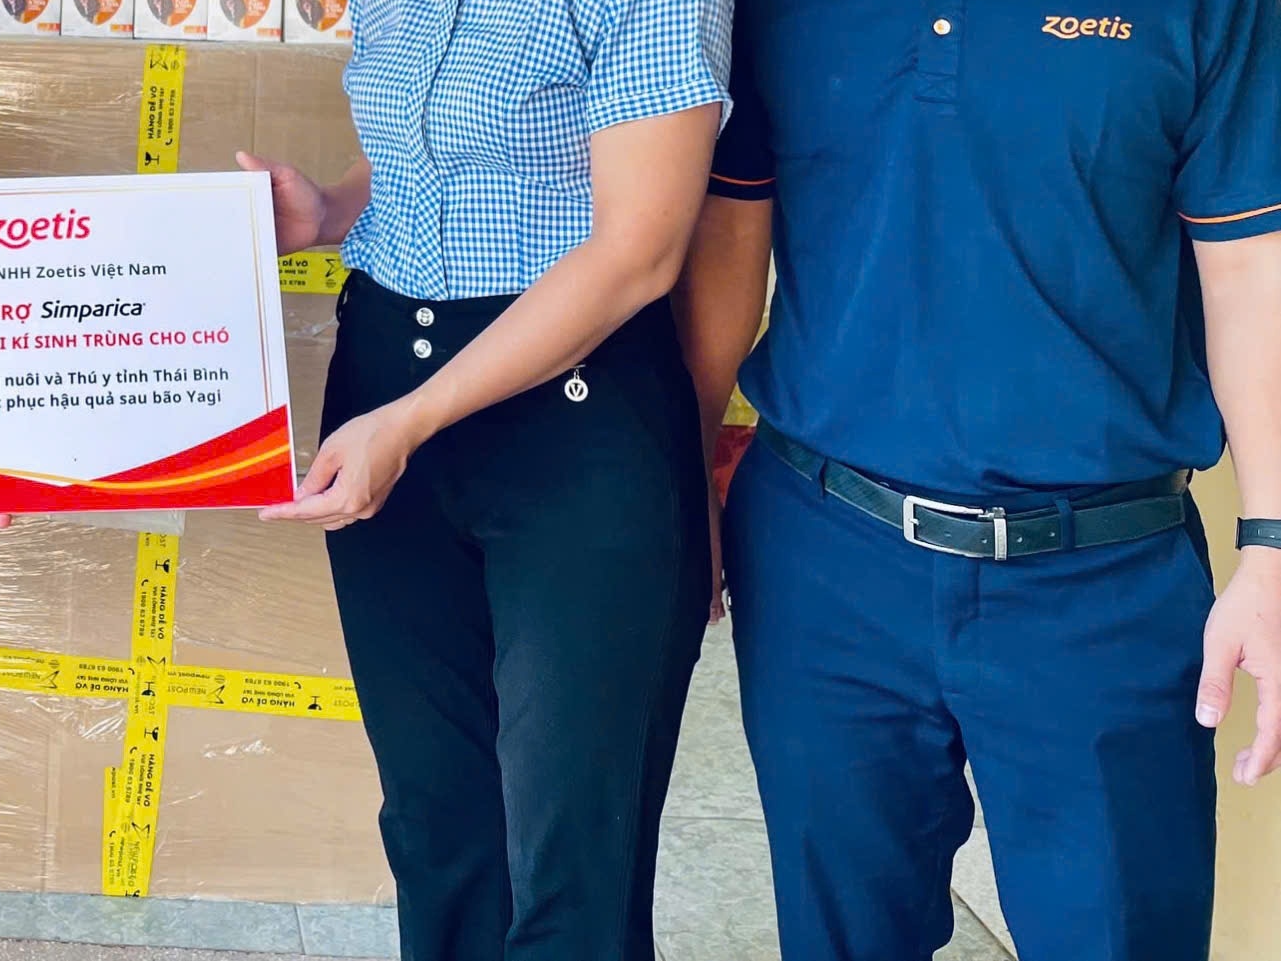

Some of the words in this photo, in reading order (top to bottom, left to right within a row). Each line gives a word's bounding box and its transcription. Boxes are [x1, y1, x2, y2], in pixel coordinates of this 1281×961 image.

[1042, 16, 1132, 39] zoetis
[36, 264, 86, 279] Zoetis
[91, 264, 124, 279] Việt
[128, 264, 167, 276] Nam
[41, 298, 144, 323] Simparica
[12, 333, 29, 350] KÍ
[35, 334, 77, 349] SINH
[83, 330, 144, 347] TRÙNG
[149, 331, 186, 345] CHO
[192, 327, 230, 345] CHÓ
[5, 372, 40, 386] nuôi
[44, 372, 63, 385] và
[68, 370, 97, 384] Thú
[102, 374, 111, 387] y
[116, 369, 148, 383] tỉnh
[153, 368, 188, 382] Thái
[193, 367, 229, 381] Bình
[6, 395, 45, 411] phục
[50, 393, 79, 410] hậu
[85, 391, 114, 409] quả
[120, 394, 147, 405] sau
[153, 390, 182, 404] bão
[187, 389, 221, 406] Yagi
